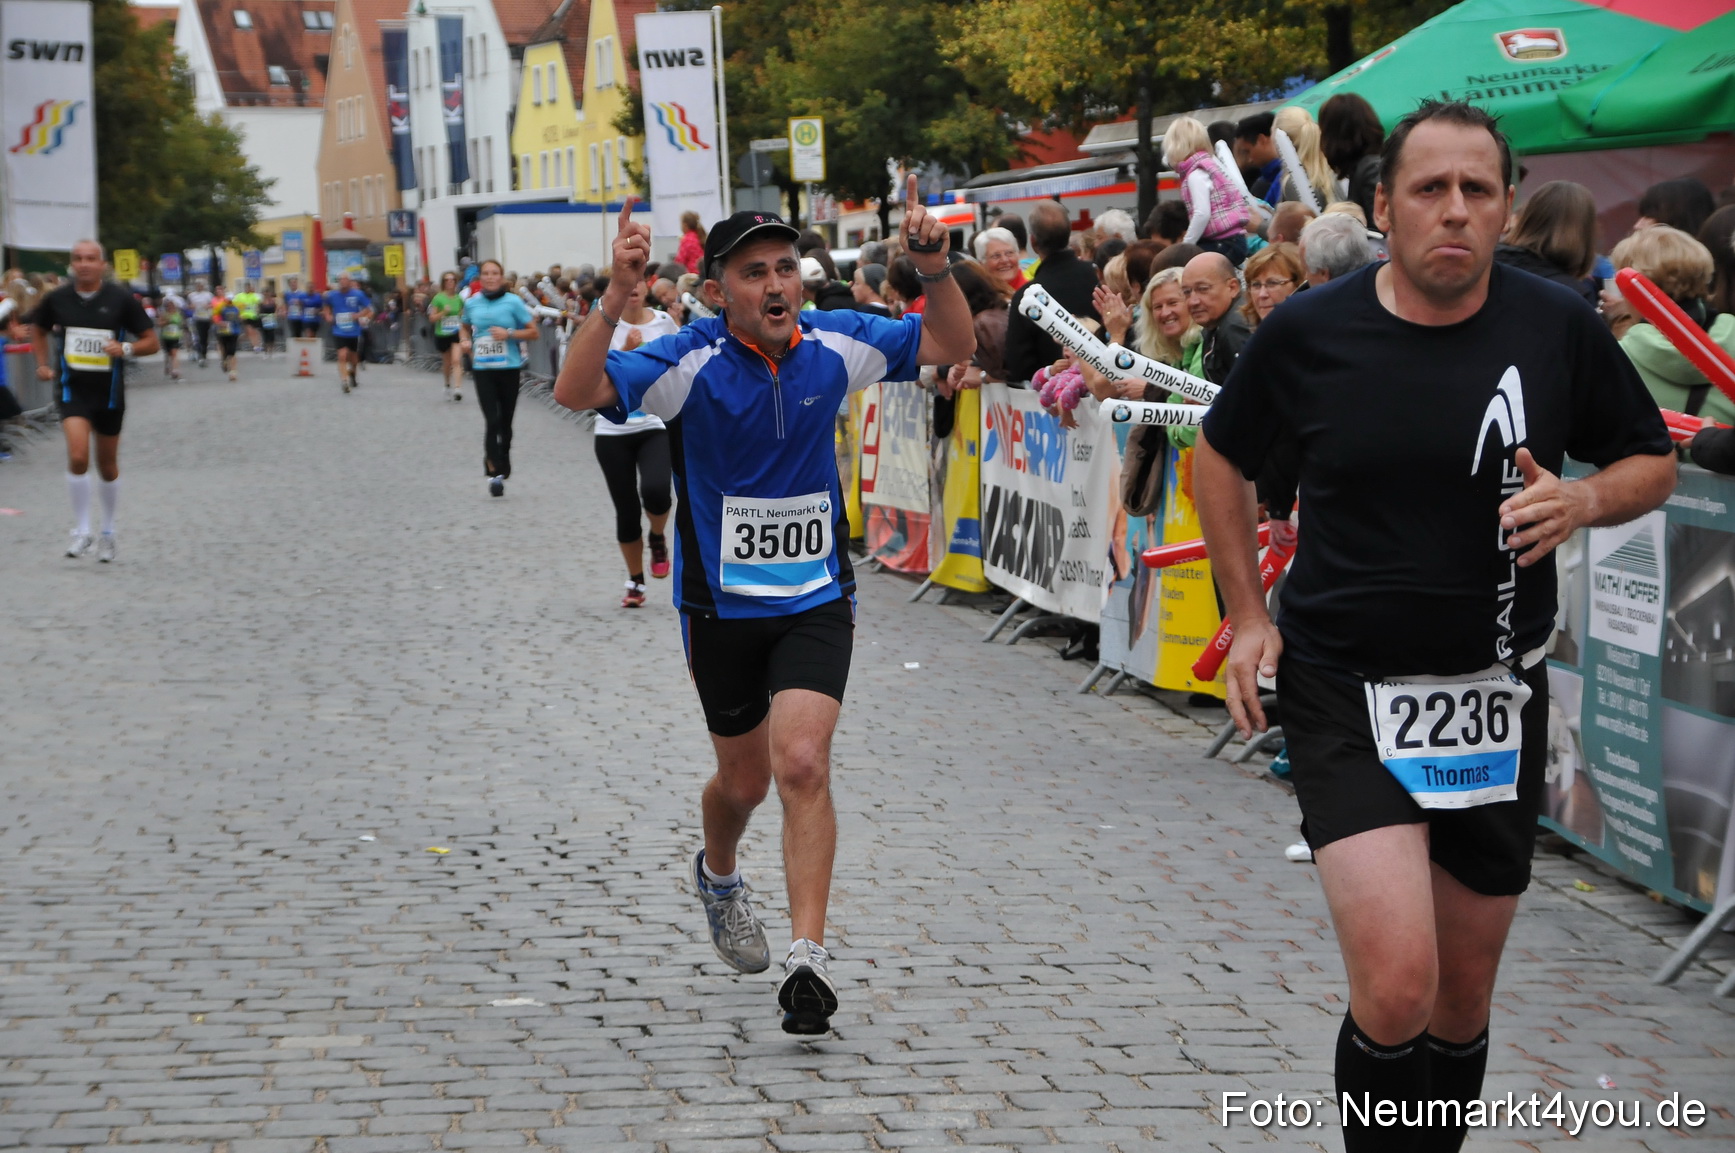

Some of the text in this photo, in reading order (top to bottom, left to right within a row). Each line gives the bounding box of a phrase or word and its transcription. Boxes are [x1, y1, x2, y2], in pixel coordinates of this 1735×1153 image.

[8, 39, 84, 62] swn
[1046, 321, 1124, 382] bmw-laufspor
[1142, 362, 1217, 402] bmw-laufs
[1141, 408, 1185, 425] BMW
[726, 504, 816, 519] PARTL Neumarkt
[733, 518, 824, 560] 3500
[1389, 689, 1513, 750] 2236
[1421, 765, 1490, 787] Thomas
